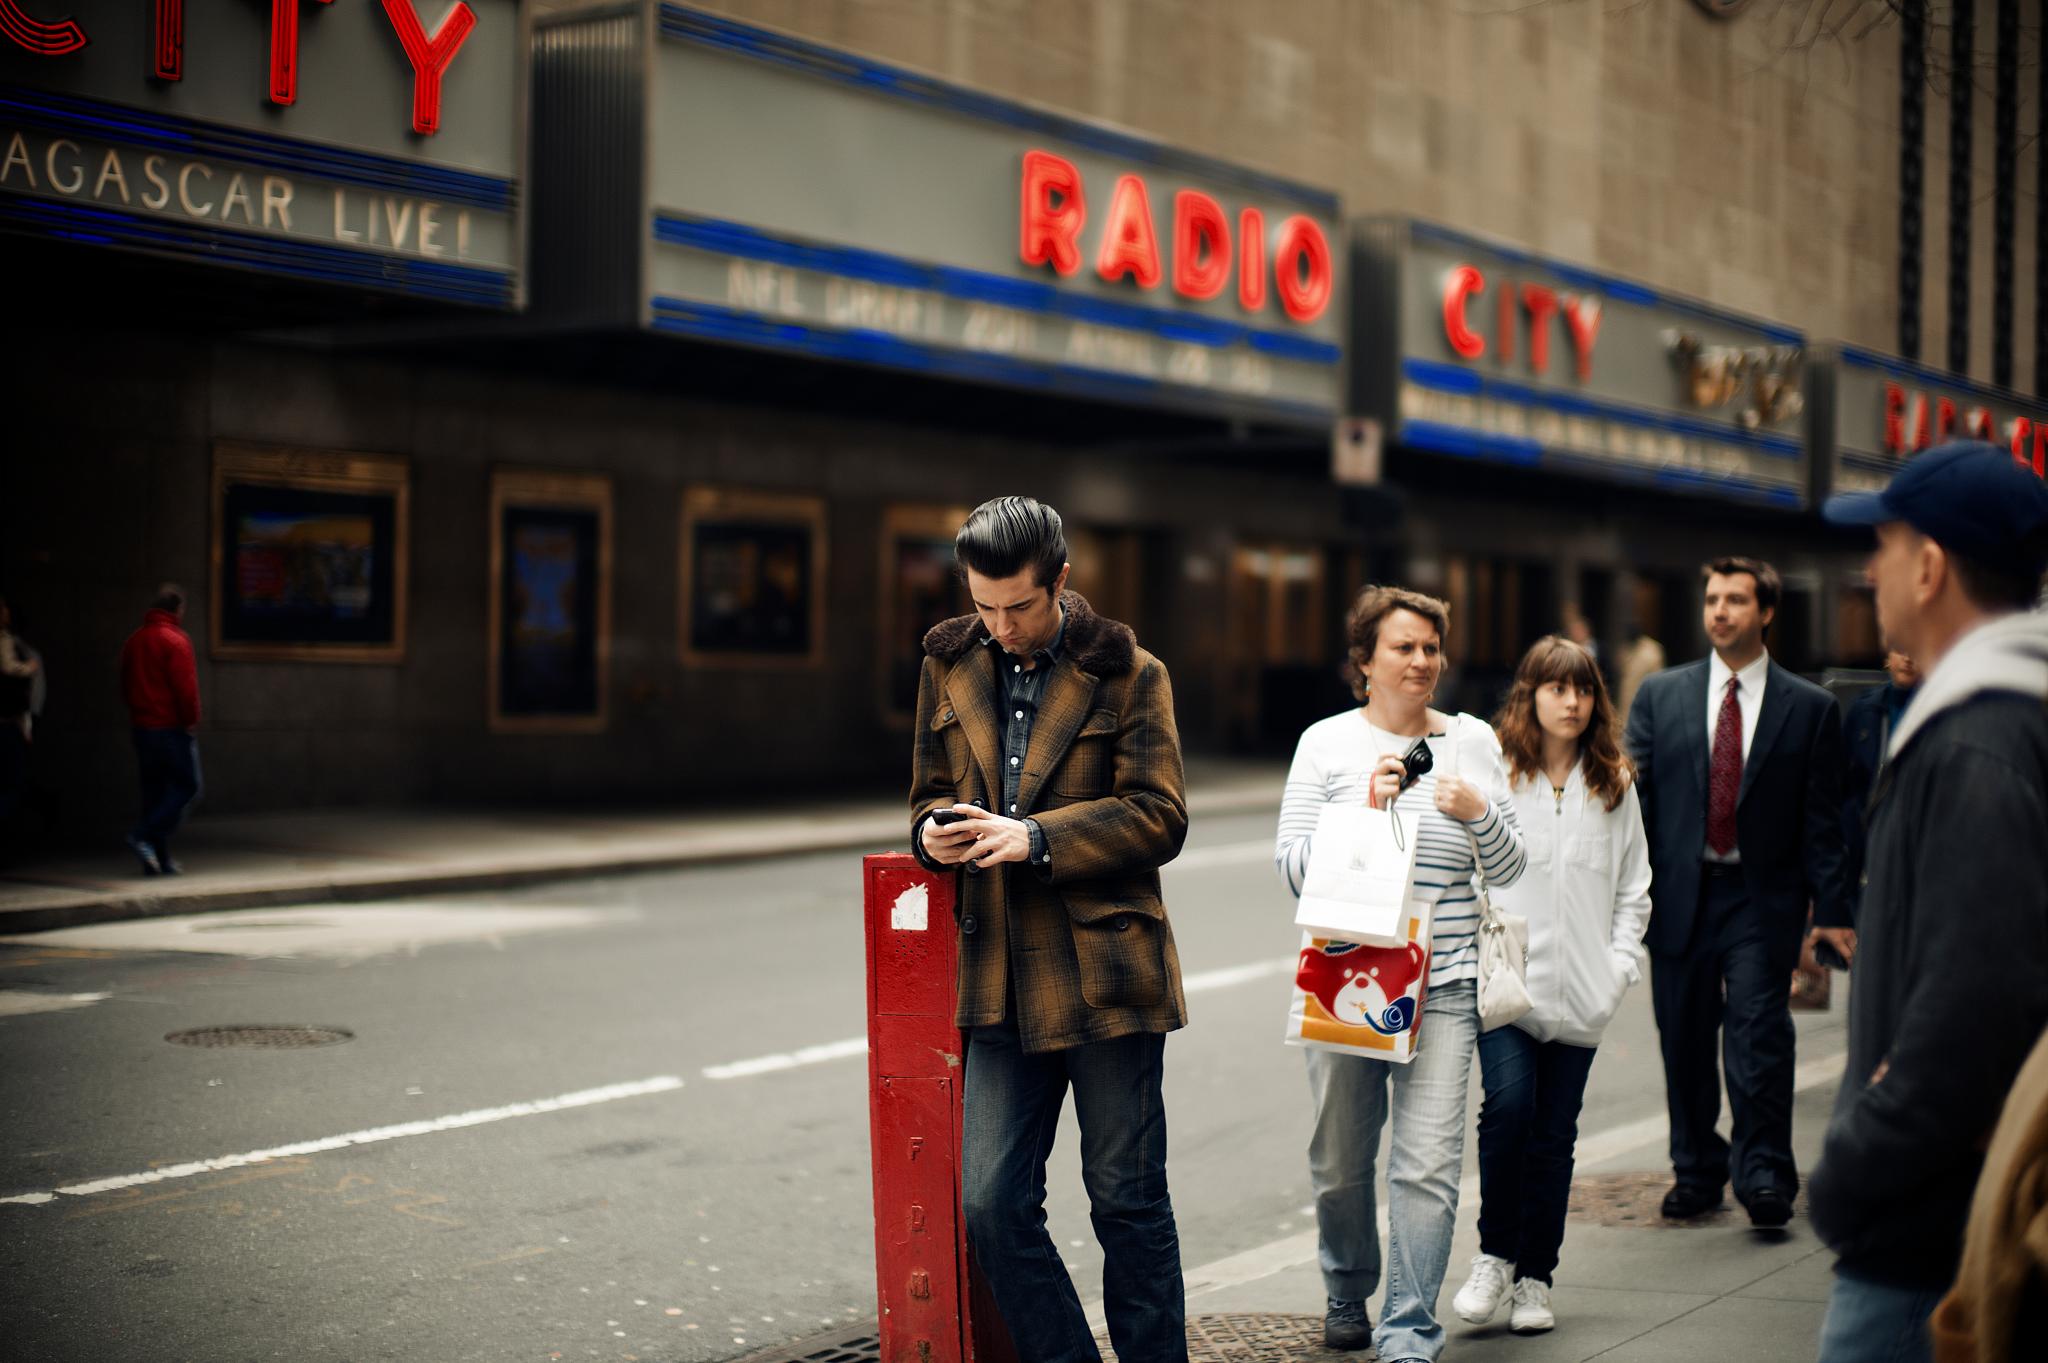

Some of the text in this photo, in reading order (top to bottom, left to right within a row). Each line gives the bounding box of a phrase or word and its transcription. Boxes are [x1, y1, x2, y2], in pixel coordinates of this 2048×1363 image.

[0, 131, 295, 232] AGASCAR
[1019, 149, 1333, 324] RADIO
[1443, 264, 1603, 386] CITY
